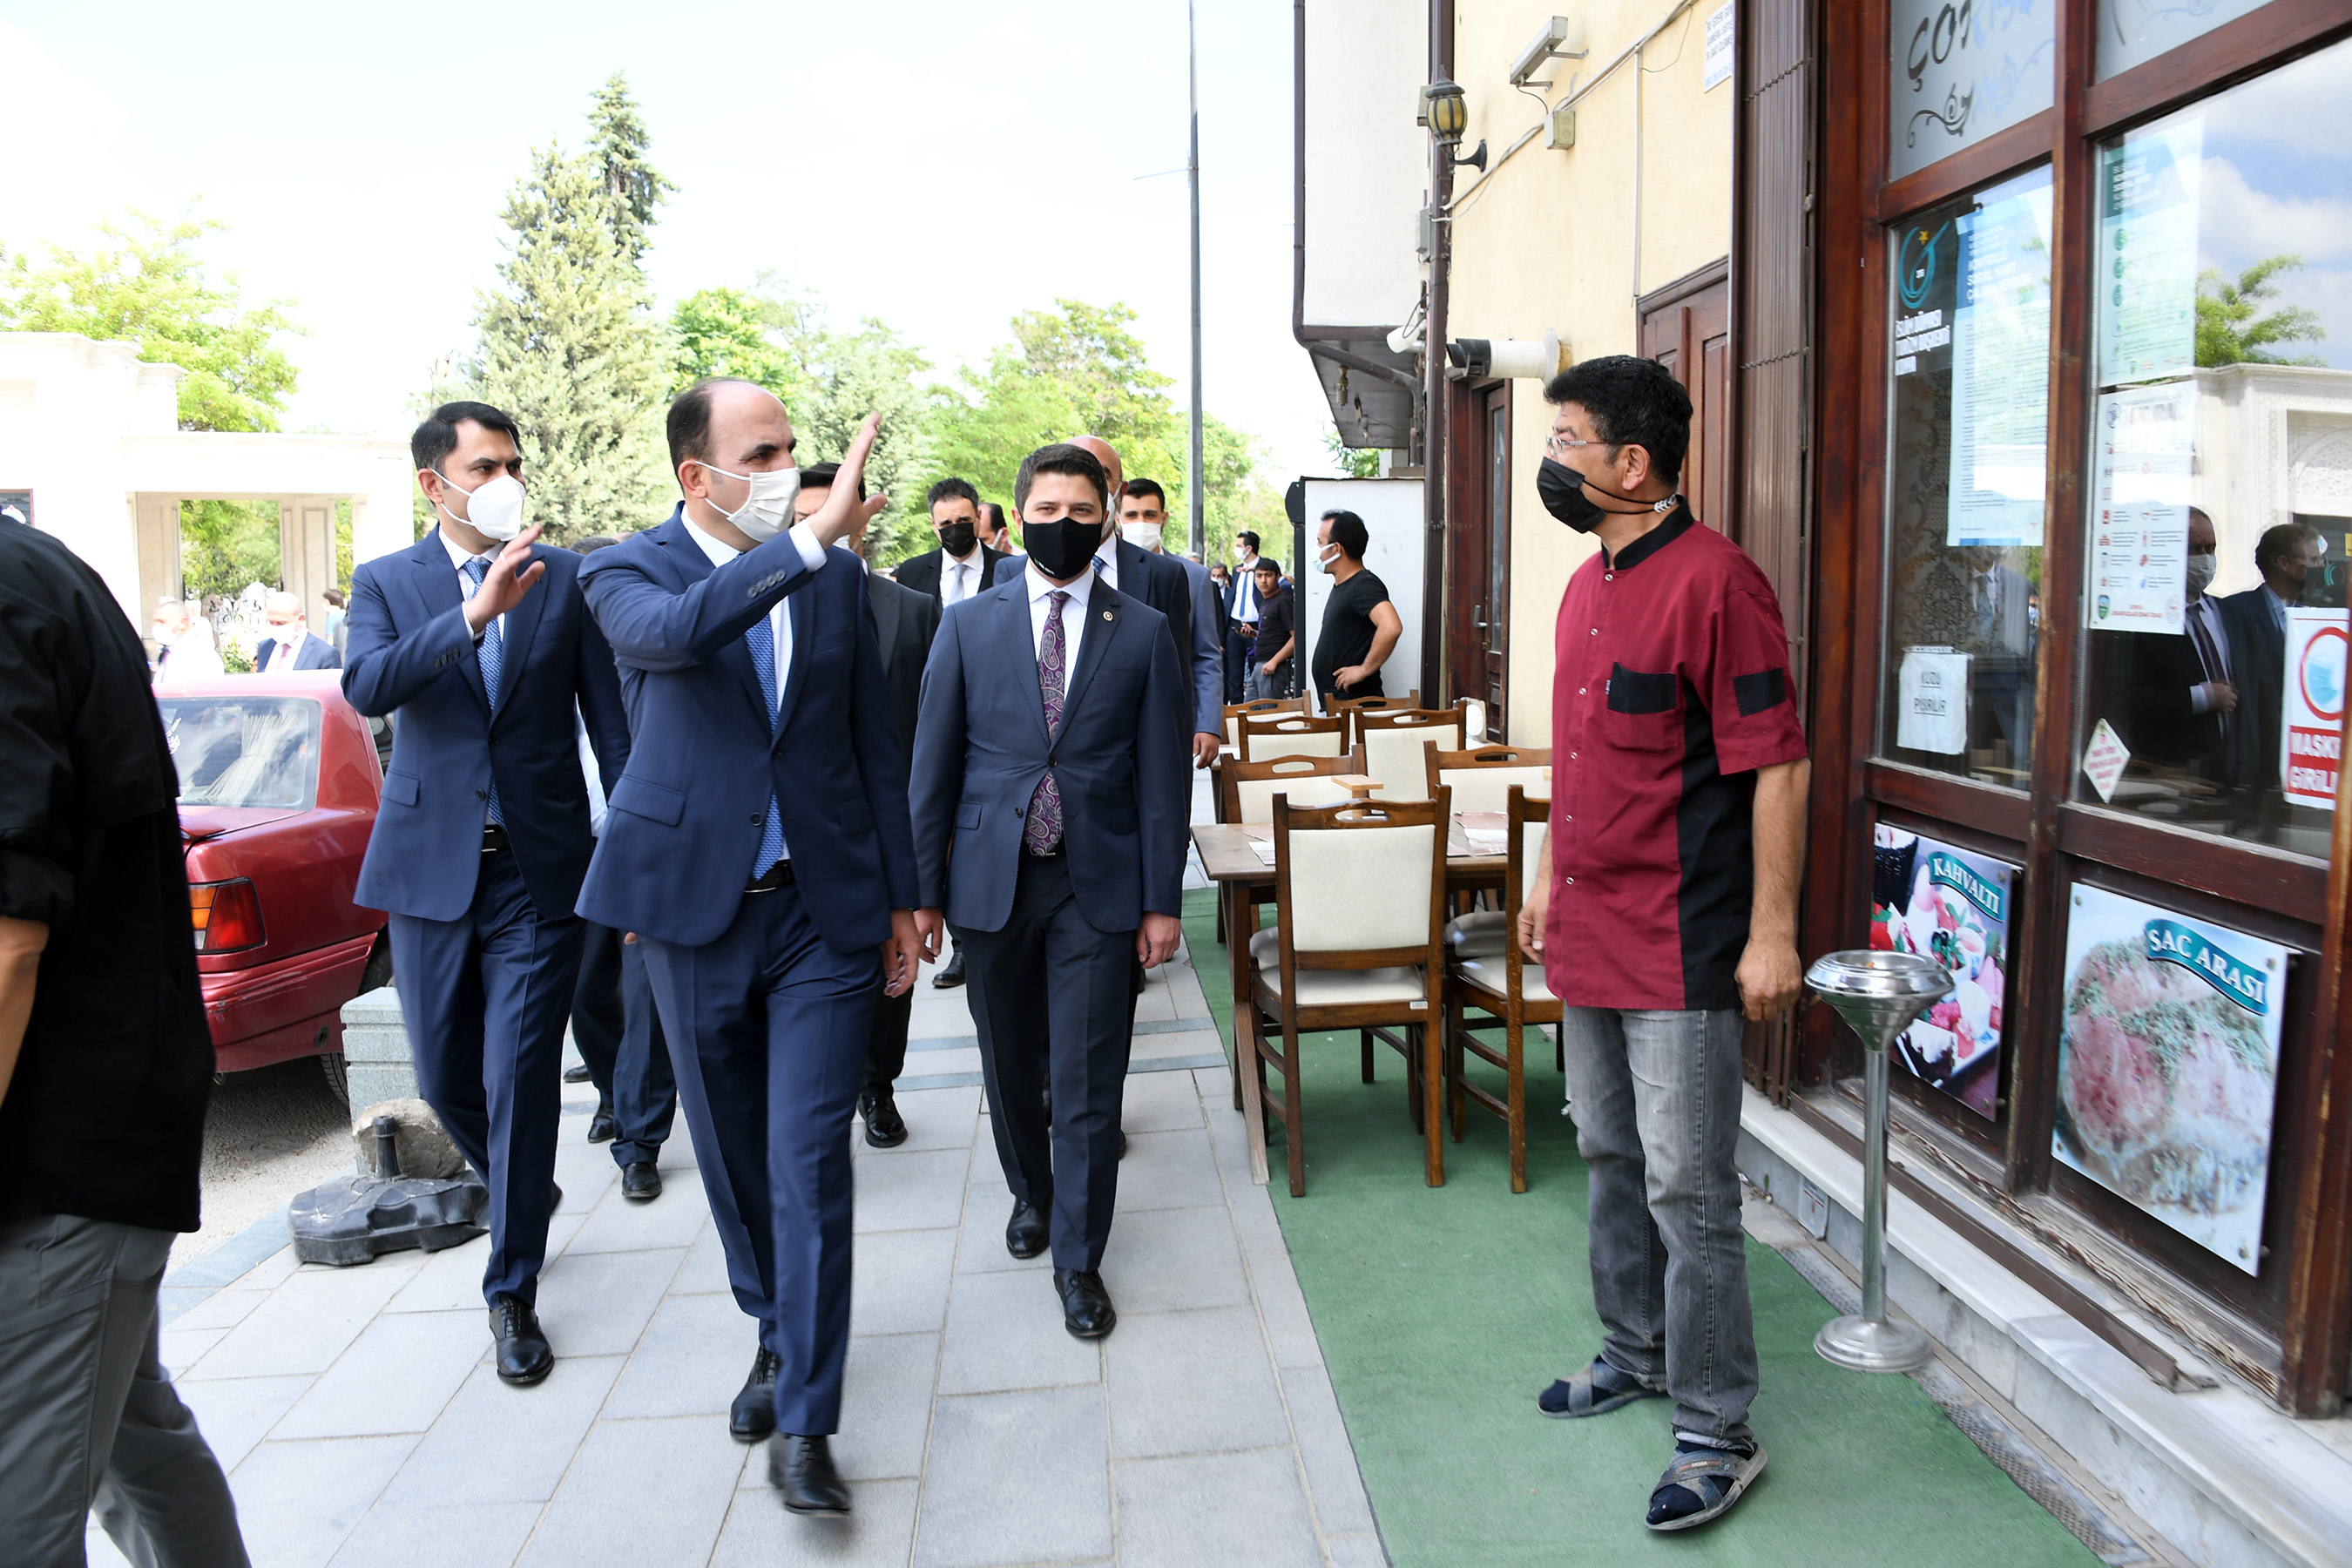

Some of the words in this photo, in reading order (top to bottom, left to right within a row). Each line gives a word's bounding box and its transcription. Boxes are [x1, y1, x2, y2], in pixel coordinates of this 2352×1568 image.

[1932, 858, 2000, 915] KAHVALTI
[2148, 929, 2193, 959] SAC
[2194, 946, 2266, 1004] ARASI
